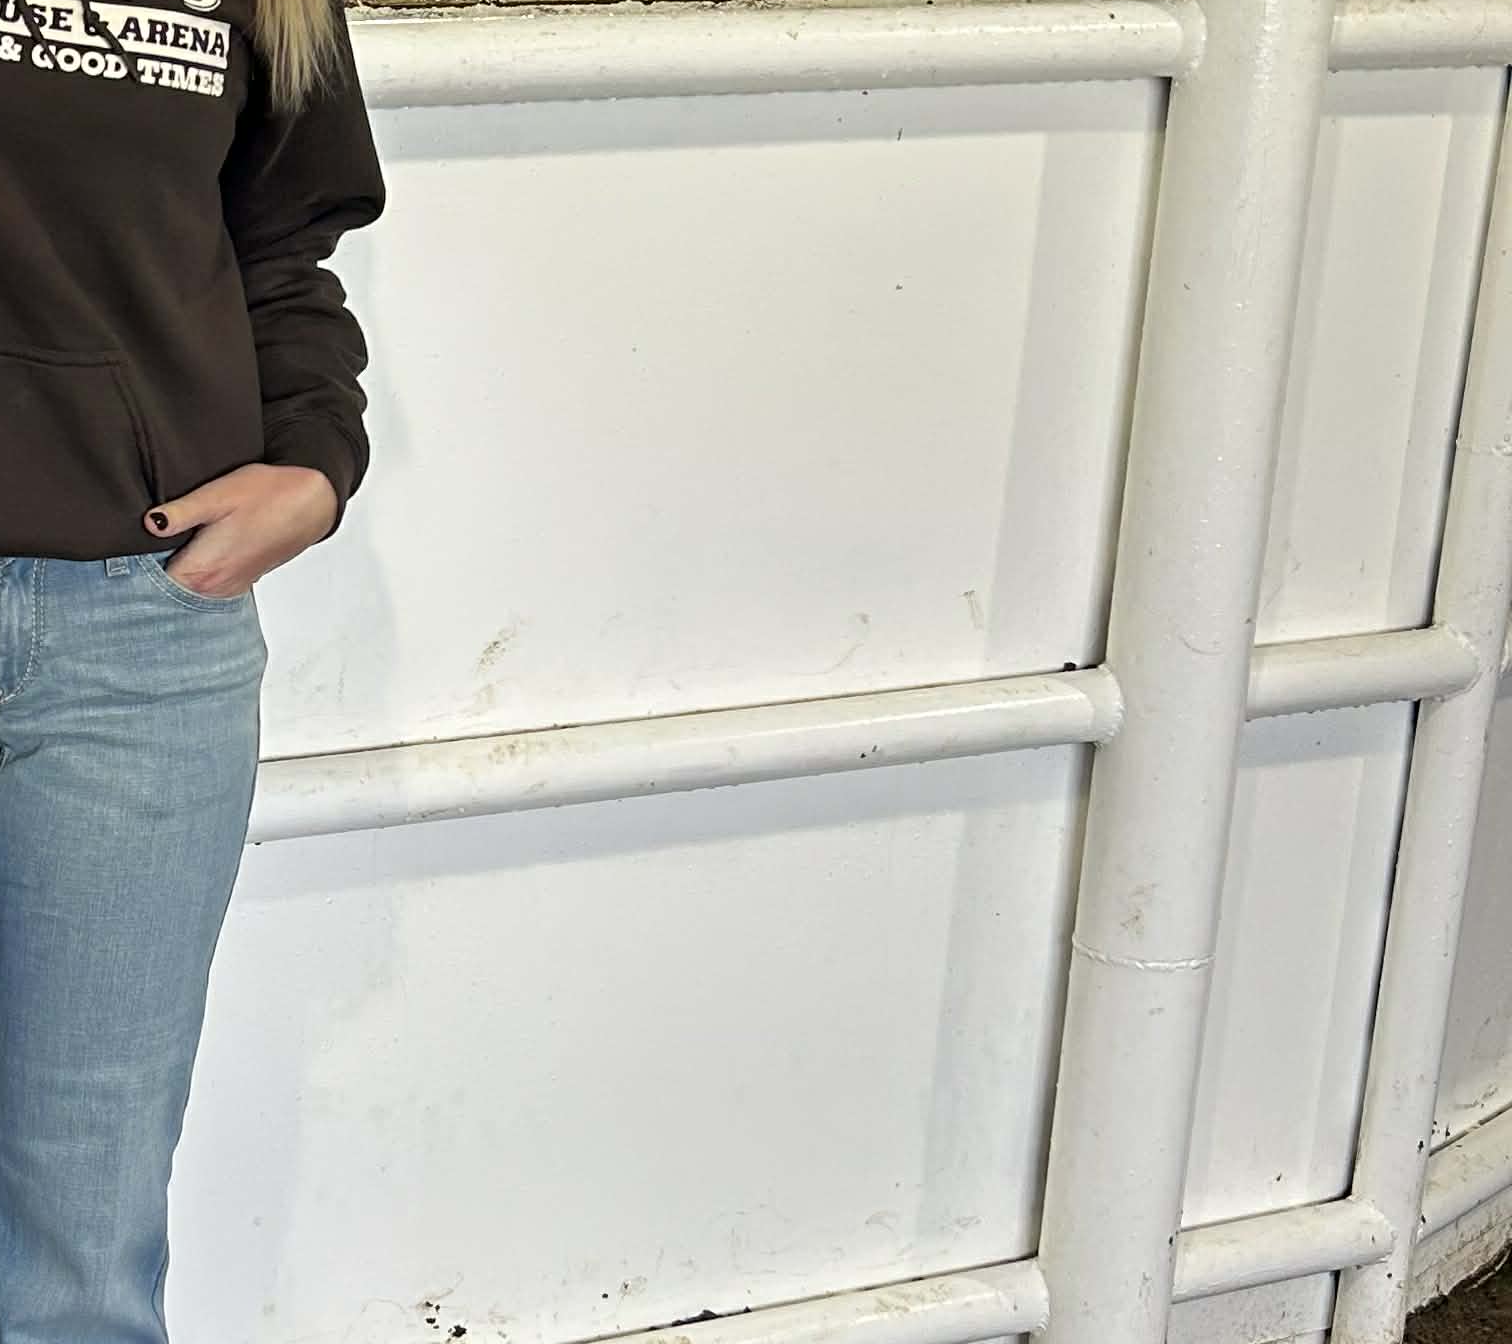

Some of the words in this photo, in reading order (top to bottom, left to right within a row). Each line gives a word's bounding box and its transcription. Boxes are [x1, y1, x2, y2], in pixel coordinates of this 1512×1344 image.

[118, 16, 226, 57] ARENA
[32, 43, 129, 81] GOOD
[136, 58, 225, 98] TIMES
